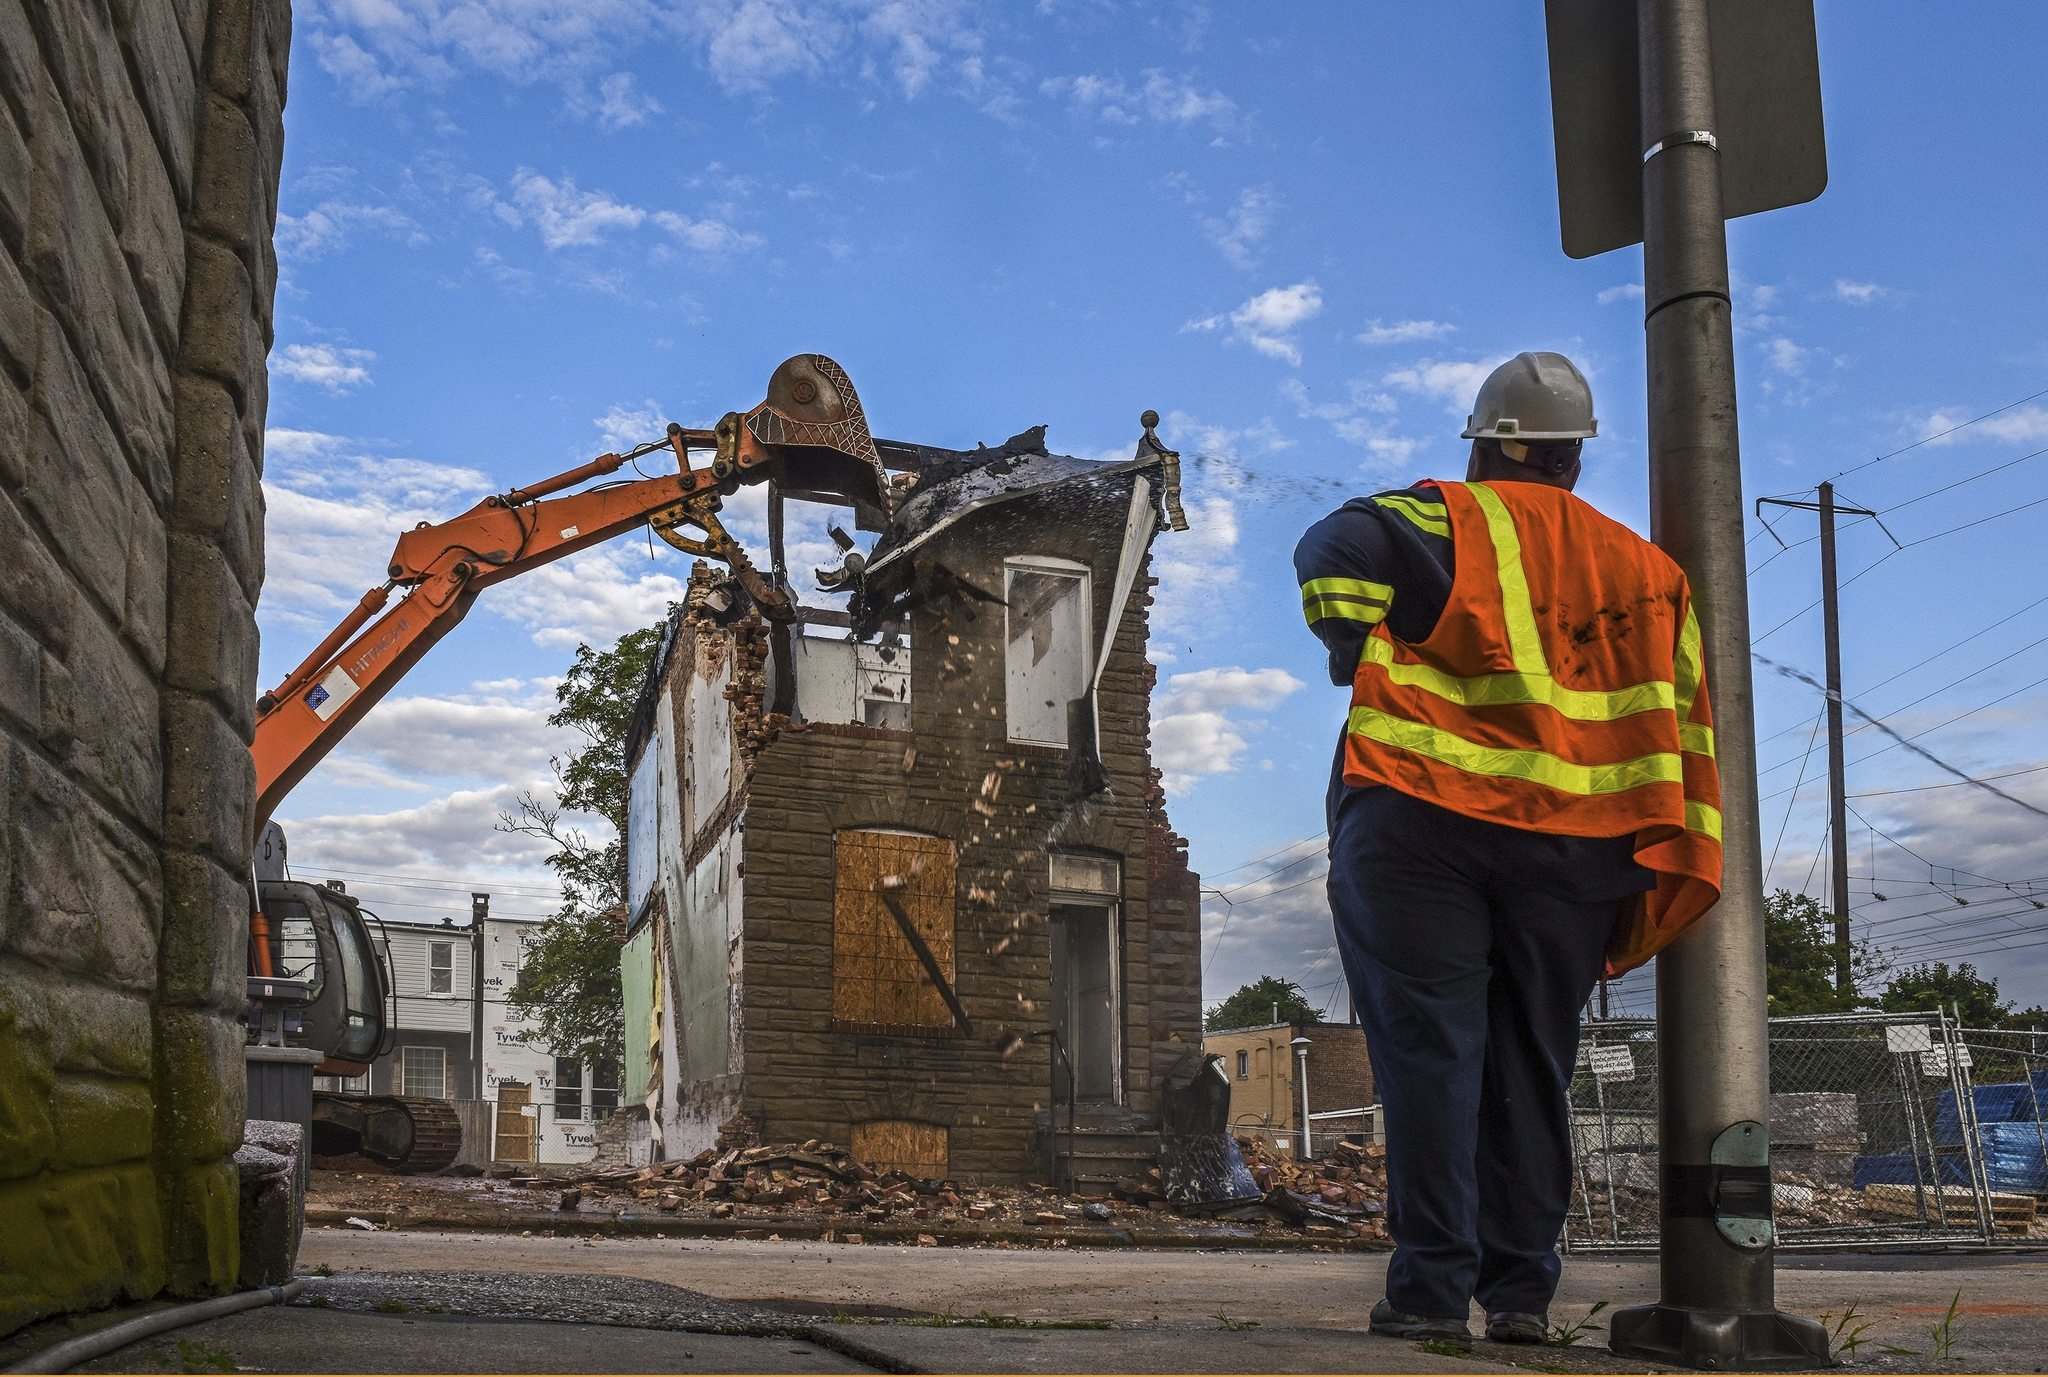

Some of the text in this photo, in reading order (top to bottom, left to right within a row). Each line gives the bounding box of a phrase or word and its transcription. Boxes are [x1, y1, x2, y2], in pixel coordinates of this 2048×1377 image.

[519, 936, 546, 947] Tyve
[483, 977, 503, 986] vek
[496, 1032, 522, 1042] Tyve
